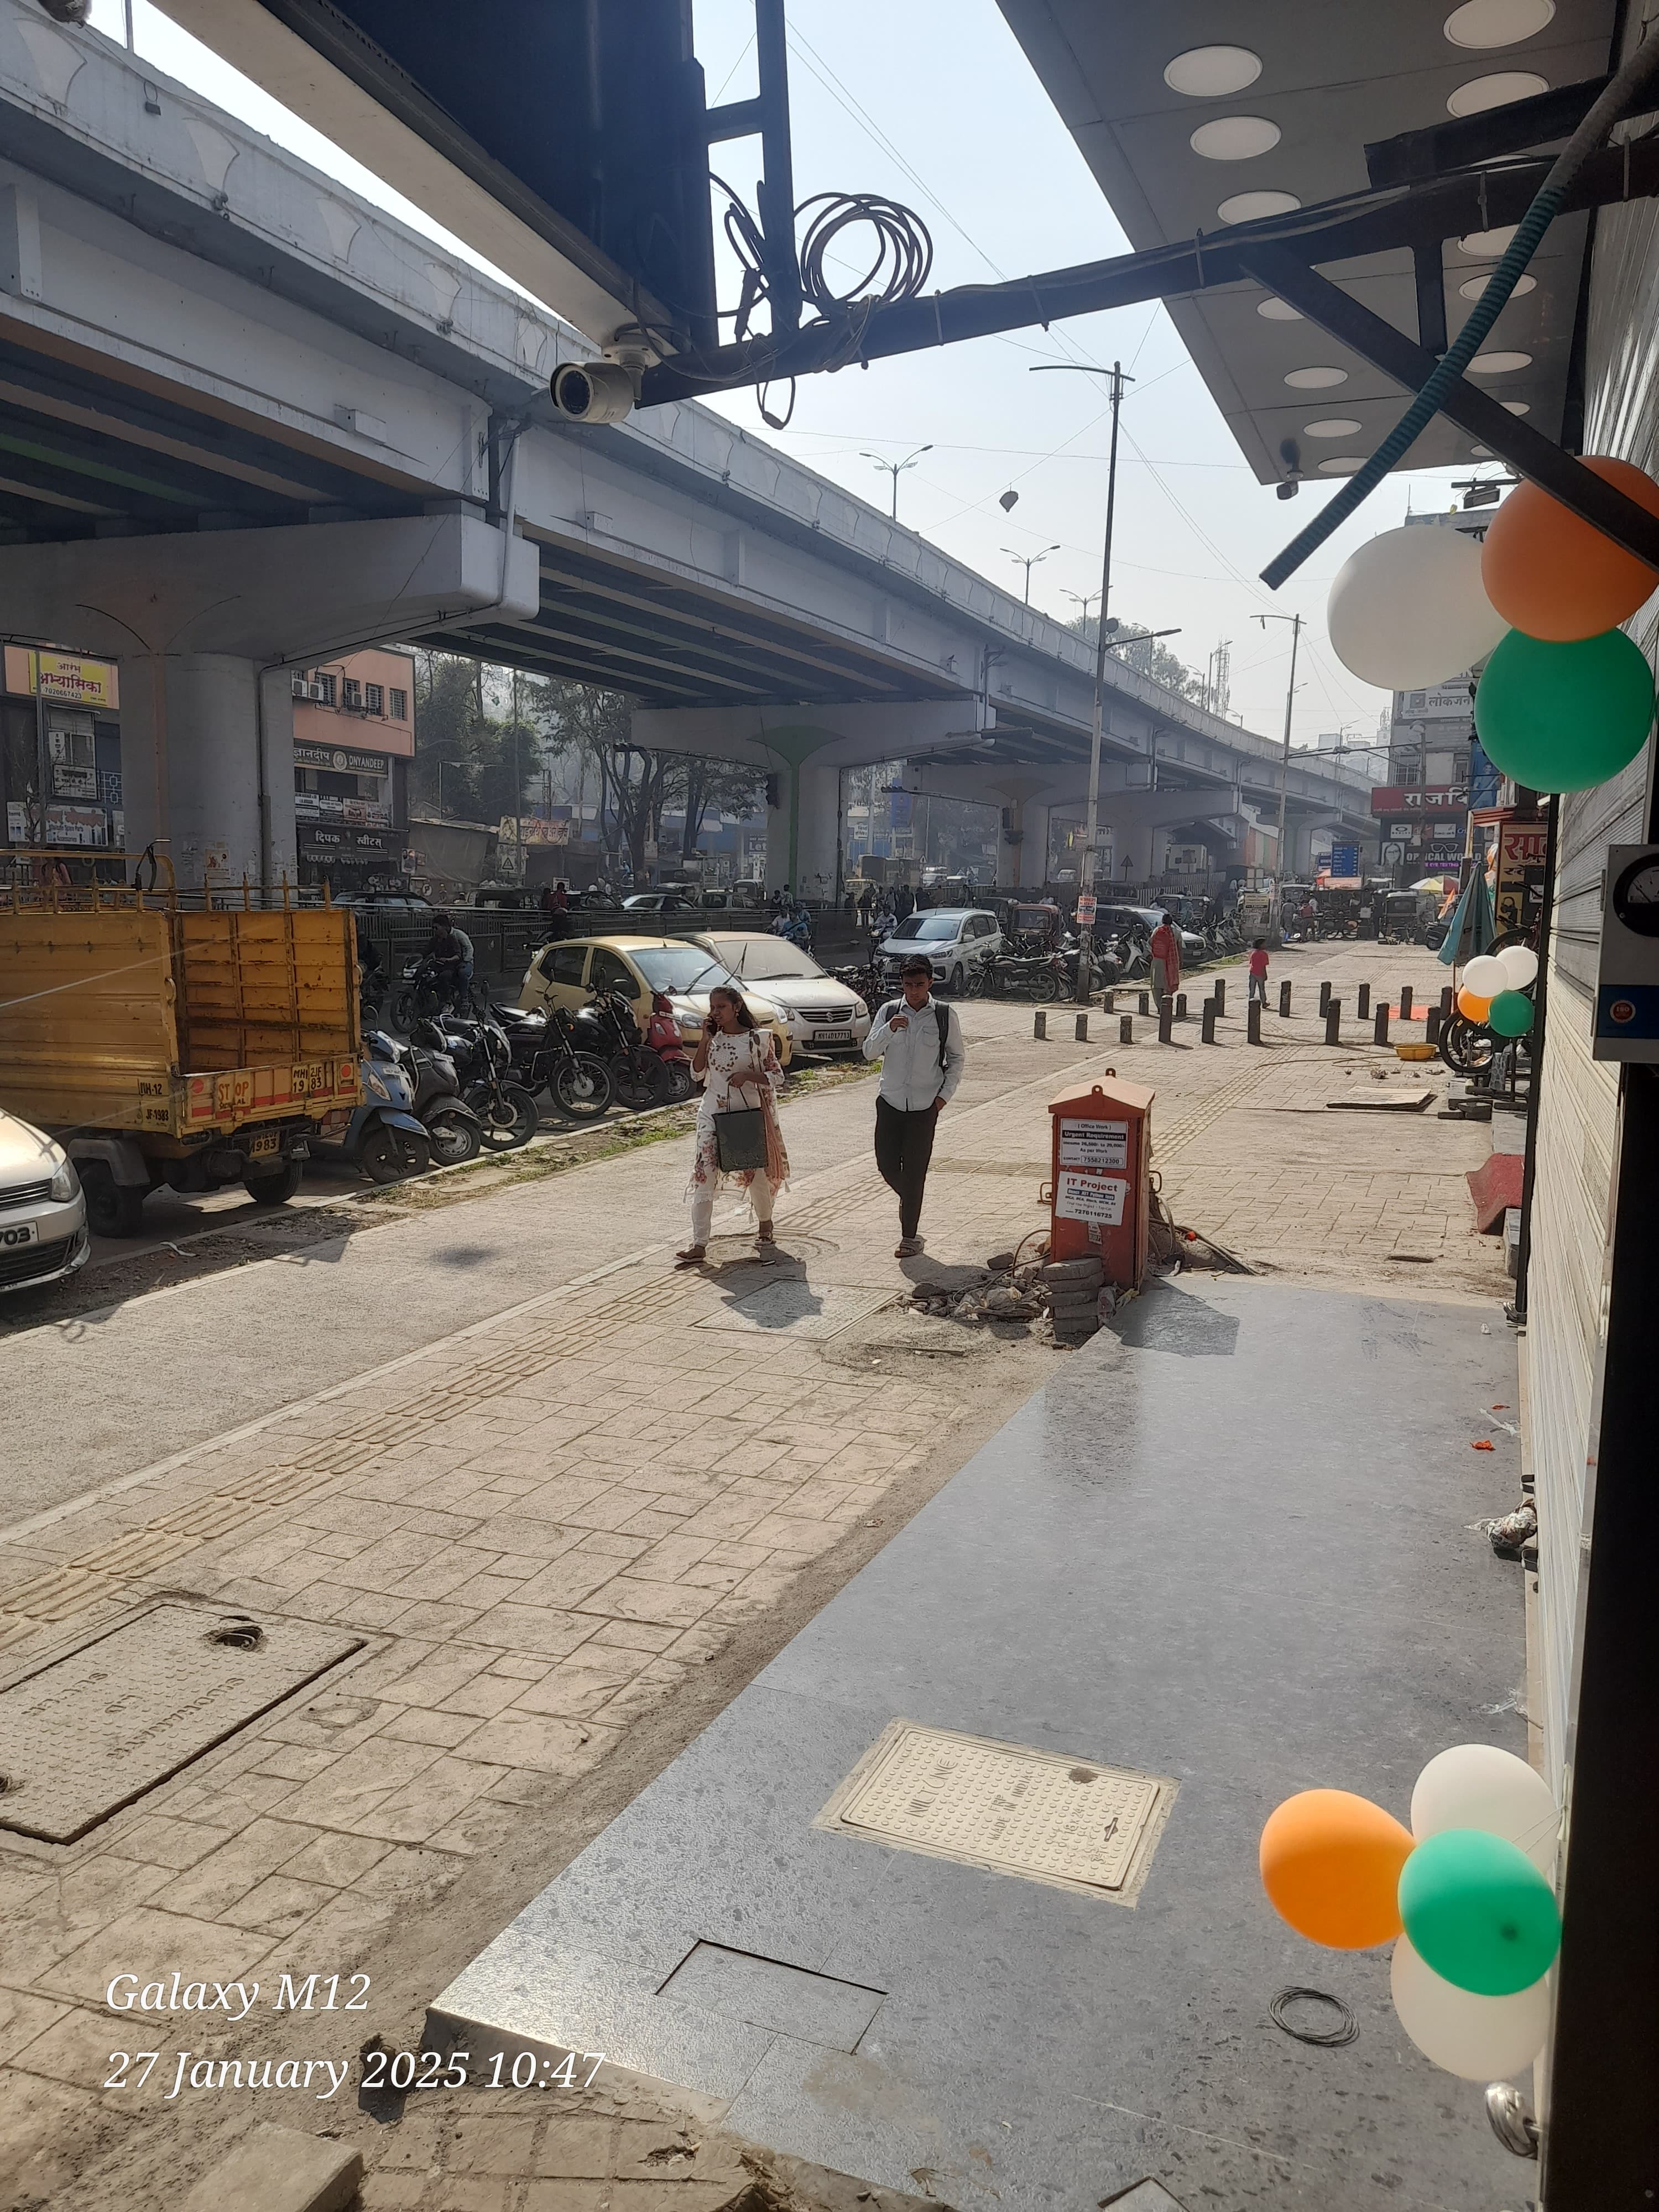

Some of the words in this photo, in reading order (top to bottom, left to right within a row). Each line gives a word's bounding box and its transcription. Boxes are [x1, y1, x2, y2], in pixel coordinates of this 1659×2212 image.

[57, 662, 81, 673] आरंभ
[349, 755, 384, 769] DNYANDEEP
[315, 830, 341, 843] दिपक
[1406, 853, 1448, 861] OPICAL
[1449, 853, 1481, 862] WOLD
[1066, 1177, 1078, 1186] IT
[1080, 1180, 1118, 1192] Project
[904, 1758, 959, 1818] NILTONE
[1010, 1776, 1031, 1798] INDIA
[988, 1794, 1007, 1812] FRP
[998, 1802, 1019, 1812] IN
[987, 1815, 1011, 1840] MADE
